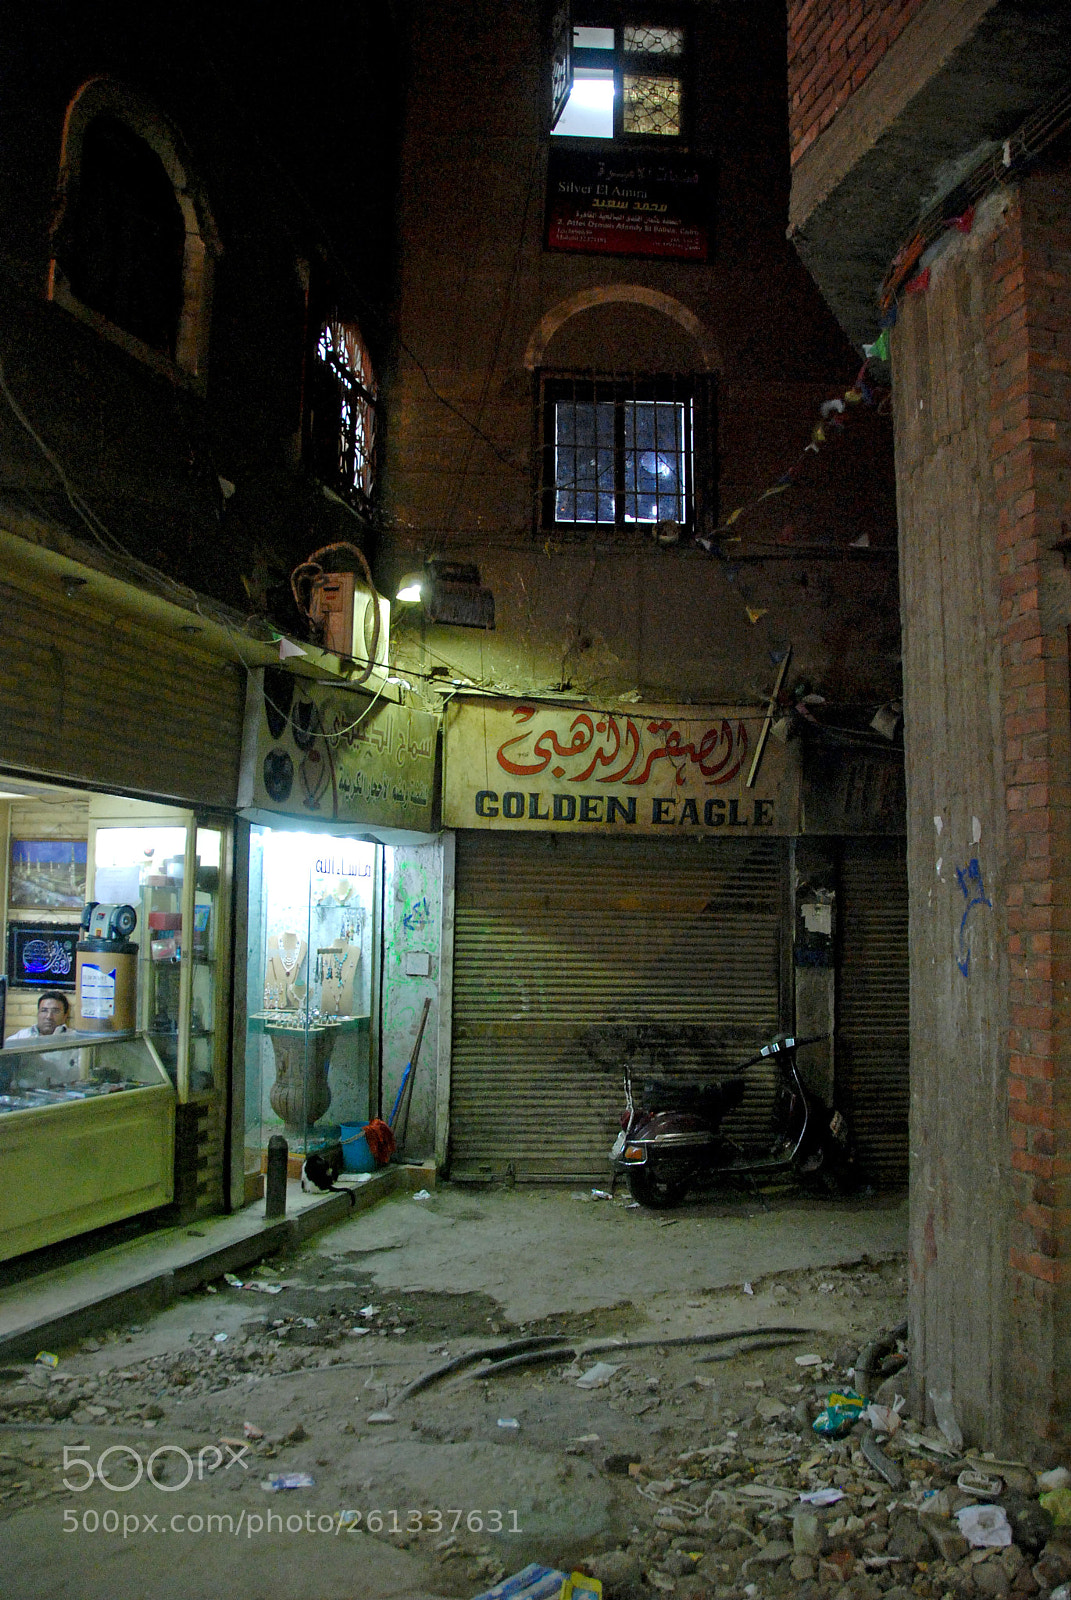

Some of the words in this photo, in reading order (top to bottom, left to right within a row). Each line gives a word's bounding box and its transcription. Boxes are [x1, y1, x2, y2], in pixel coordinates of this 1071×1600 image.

[557, 180, 592, 194] Silver
[595, 183, 609, 196] El
[633, 201, 668, 213] محمد
[475, 790, 637, 824] GOLDEN
[651, 796, 775, 827] EAGLE
